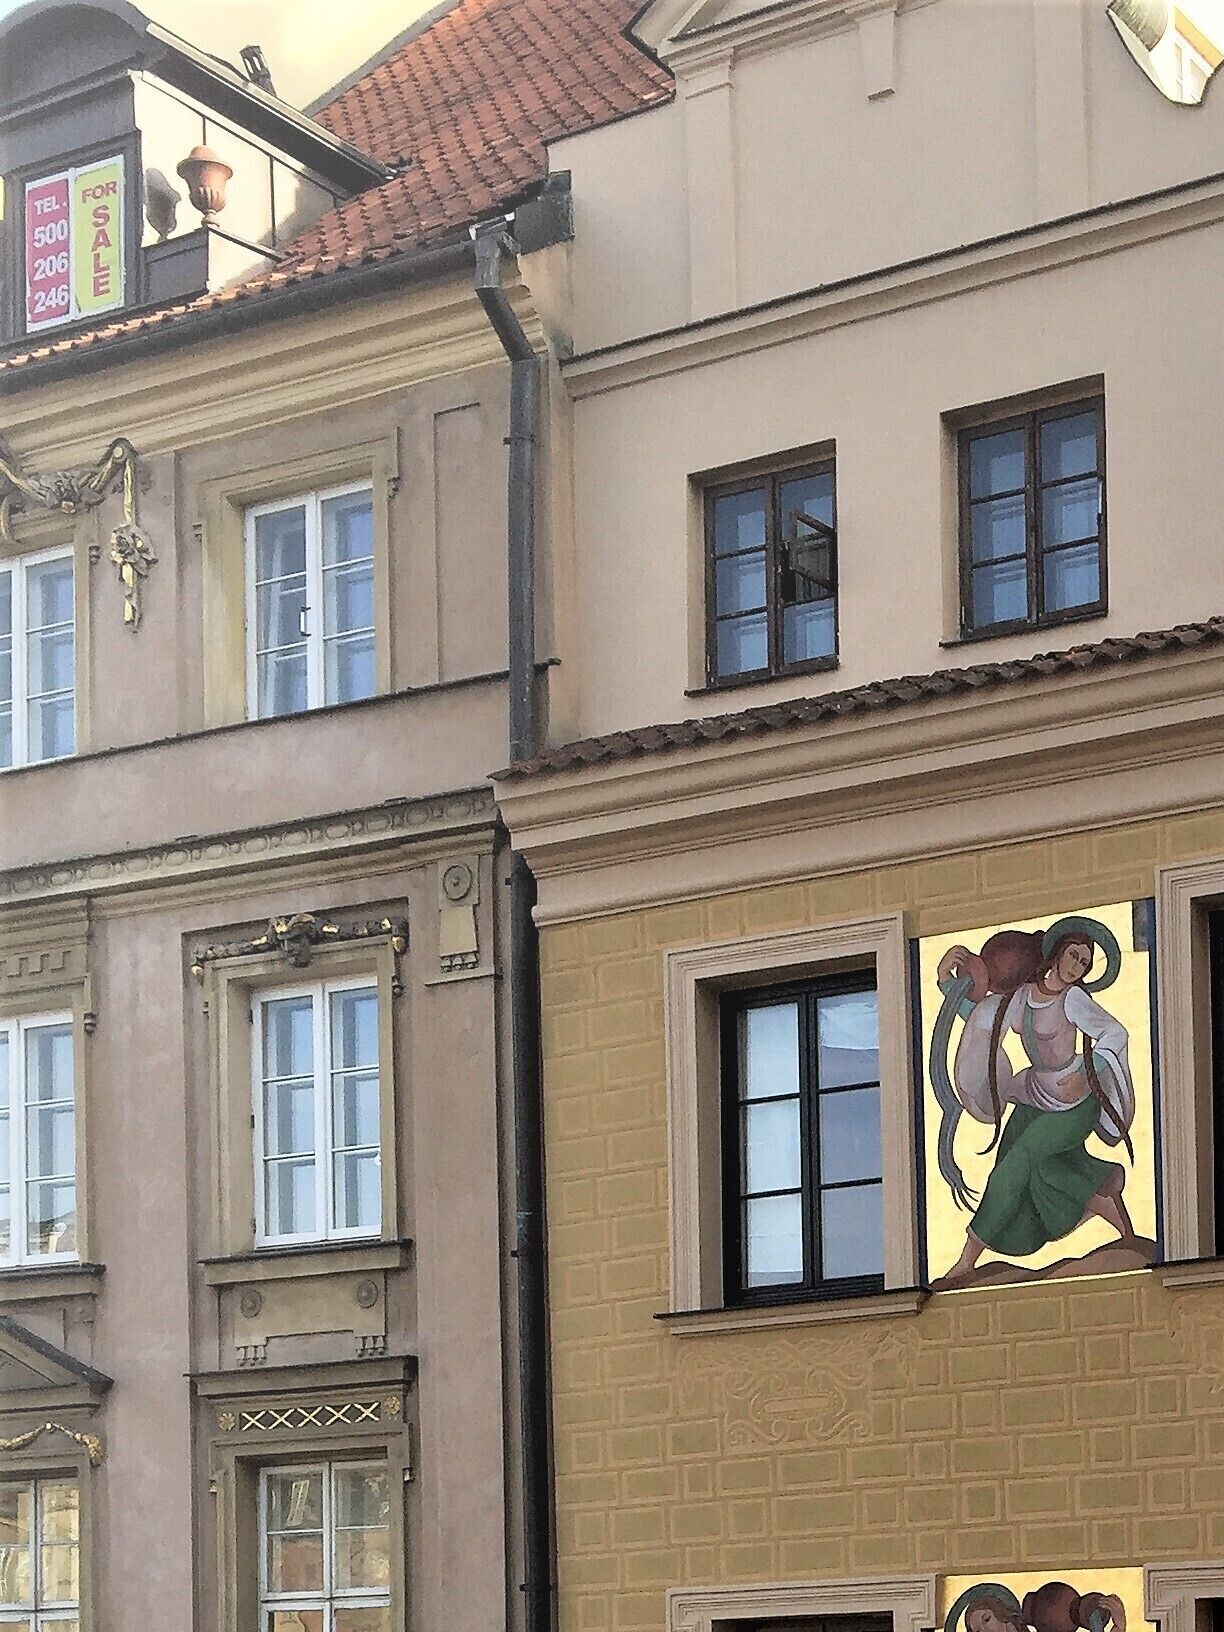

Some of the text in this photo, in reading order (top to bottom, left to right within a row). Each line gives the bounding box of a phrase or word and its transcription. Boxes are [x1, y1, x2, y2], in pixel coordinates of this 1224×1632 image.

[81, 181, 117, 203] FOR
[33, 219, 68, 248] 500
[92, 204, 112, 297] SALE
[33, 251, 68, 281] 206
[33, 284, 68, 313] 246
